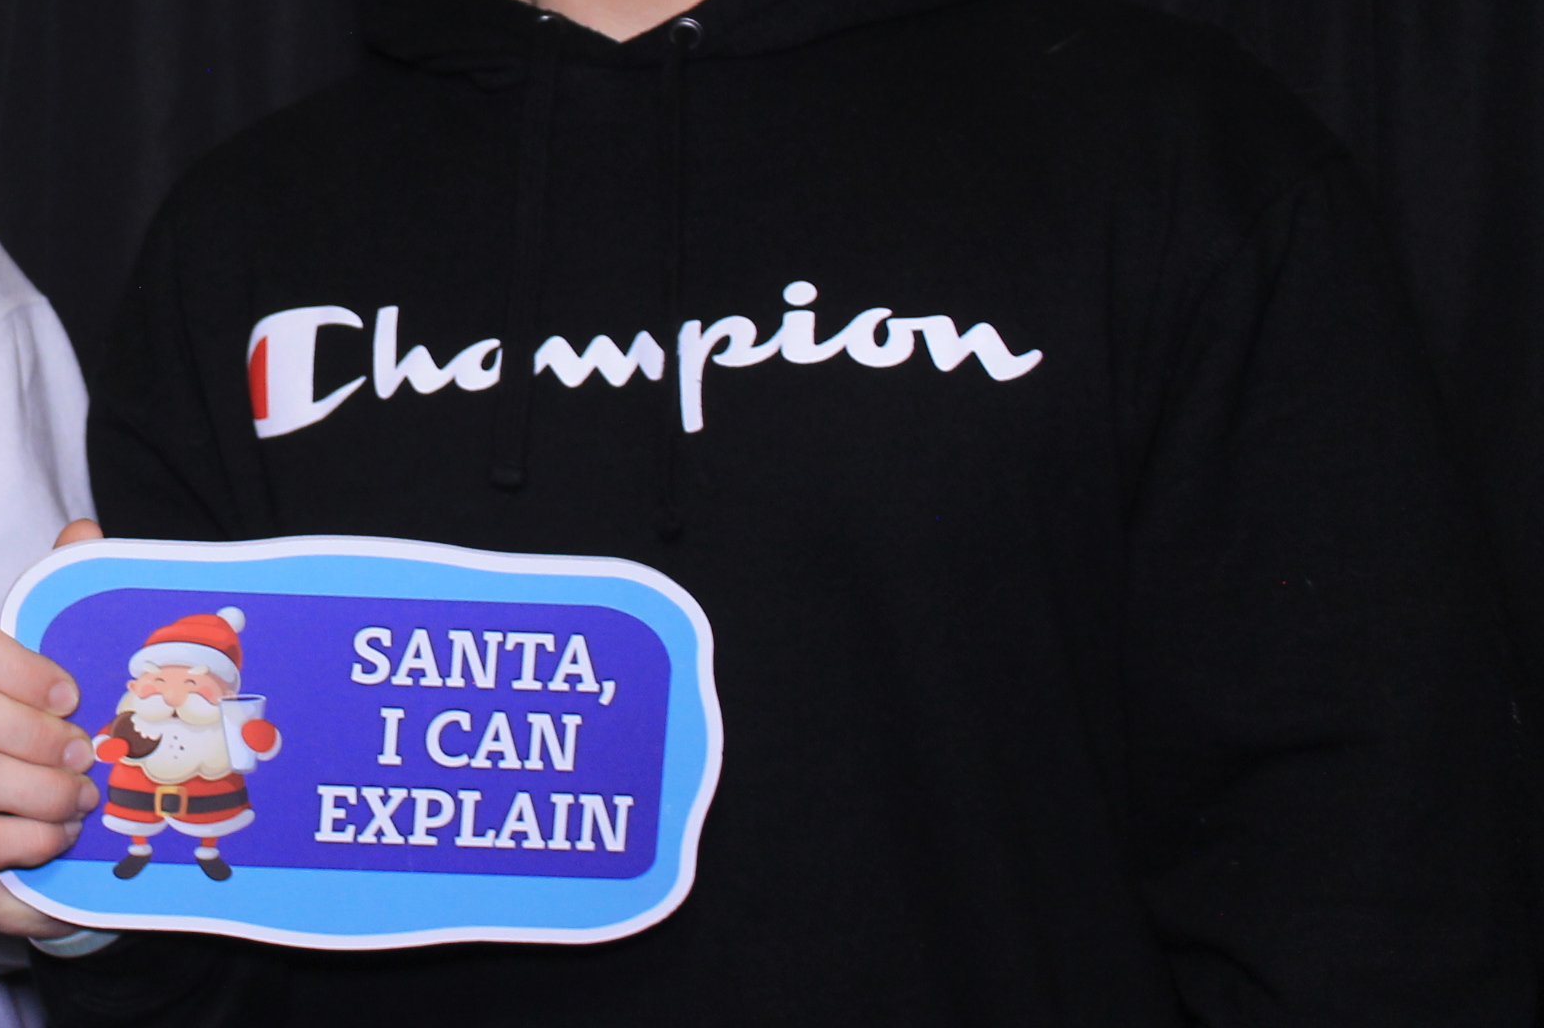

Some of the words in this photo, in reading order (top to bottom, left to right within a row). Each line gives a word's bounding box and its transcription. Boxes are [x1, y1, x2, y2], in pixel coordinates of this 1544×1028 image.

[248, 281, 1043, 438] Champion
[351, 627, 616, 706] SANTA,
[378, 708, 404, 766] I
[426, 710, 583, 772] CAN
[314, 785, 634, 852] EXPLAIN
